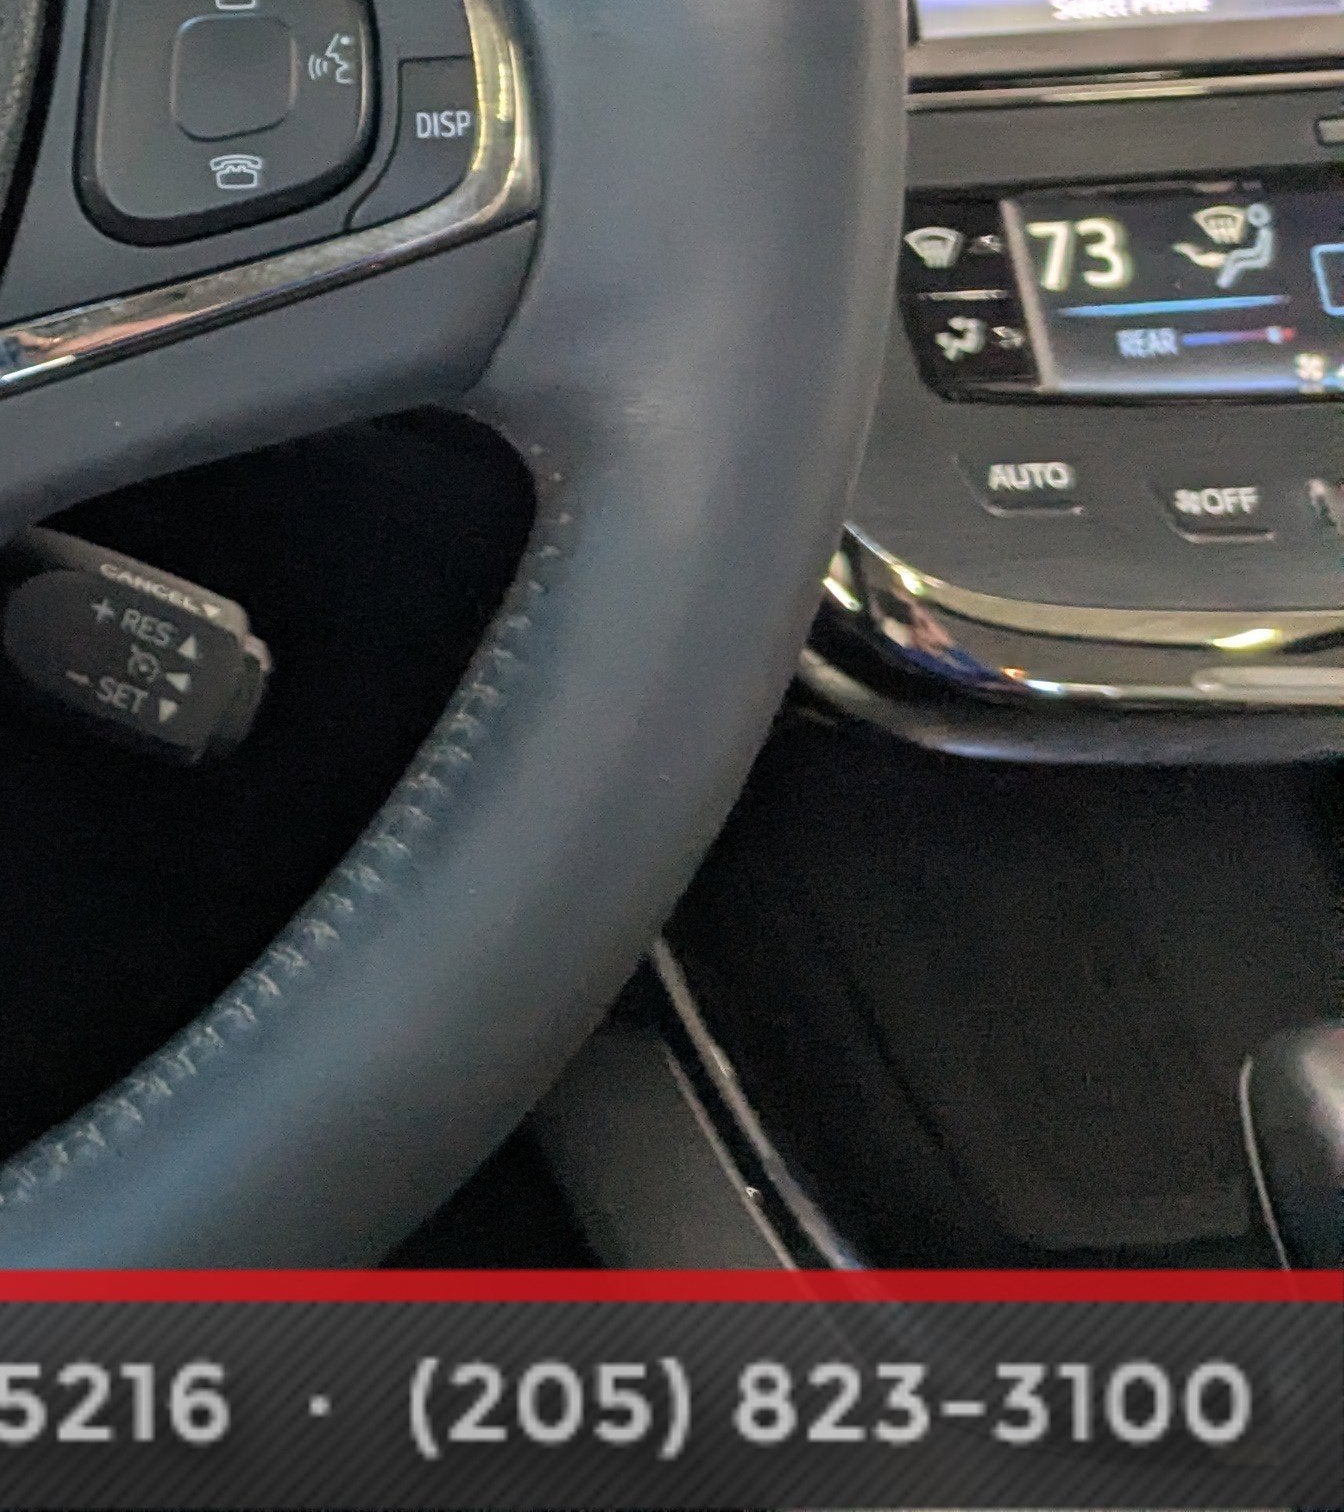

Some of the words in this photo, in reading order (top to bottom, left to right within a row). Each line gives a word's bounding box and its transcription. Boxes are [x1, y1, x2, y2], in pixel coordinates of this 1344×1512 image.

[416, 110, 472, 139] DISP
[1027, 218, 1133, 290] 73
[1117, 328, 1179, 358] REAR
[989, 462, 1073, 490] AUTO
[1200, 487, 1261, 514] OFF
[100, 563, 205, 614] CANCEL
[120, 607, 179, 648] RES
[96, 676, 150, 714] SET
